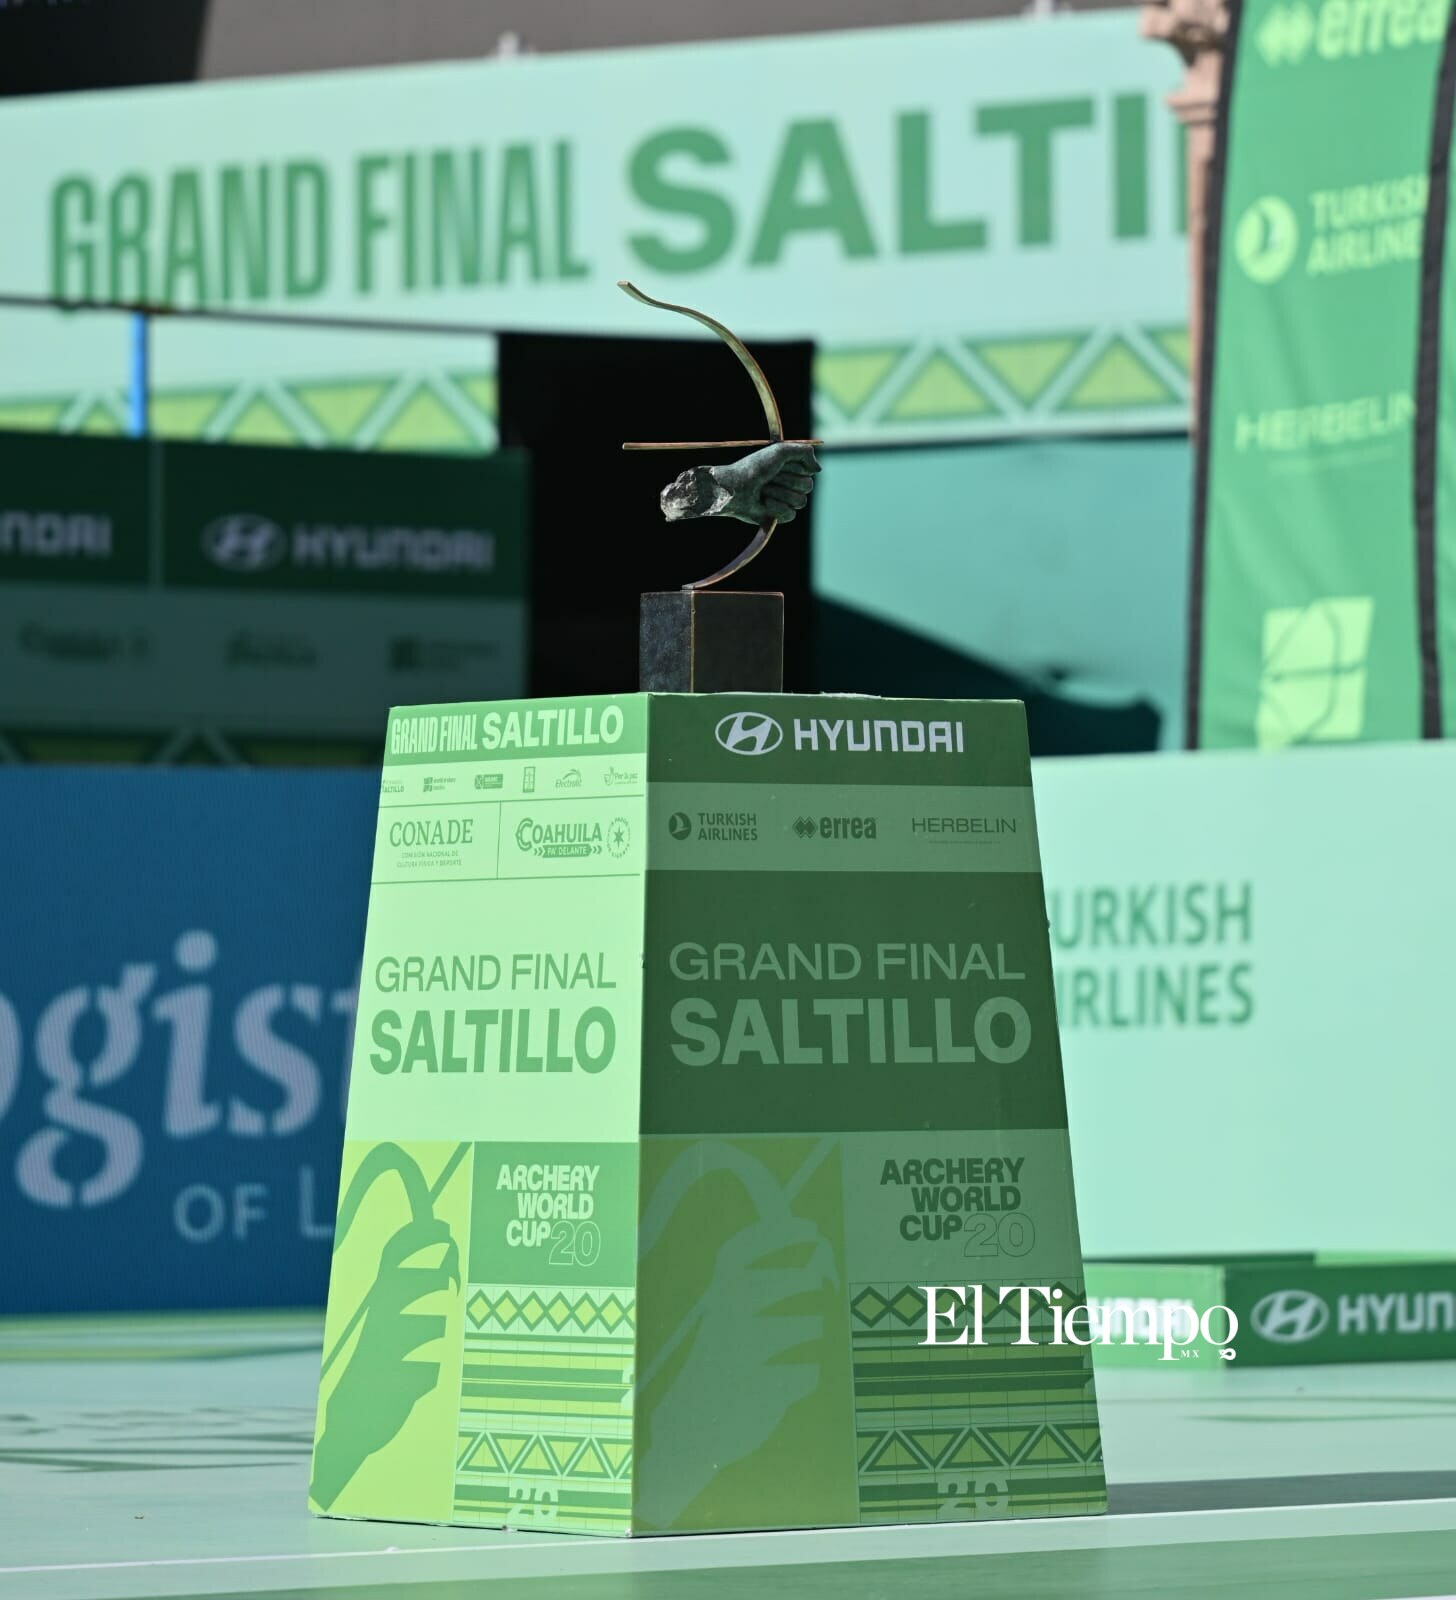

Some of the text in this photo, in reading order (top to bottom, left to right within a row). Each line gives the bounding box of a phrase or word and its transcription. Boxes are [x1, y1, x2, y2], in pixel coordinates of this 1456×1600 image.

[48, 87, 1188, 317] GRAND FINAL SALTI
[292, 522, 496, 572] HYUNDAI
[391, 705, 624, 755] GRAND FINAL SALTILLO
[794, 719, 964, 753] HYUNDAI
[381, 784, 405, 793] ALTILLO
[389, 818, 474, 847] CONADE
[515, 817, 603, 852] COAHUILA
[697, 812, 758, 827] TURKISH
[697, 827, 758, 842] AIRLINES
[820, 816, 877, 840] errea
[911, 817, 1017, 834] HERBELIN
[1050, 879, 1254, 950] URKISH
[375, 952, 617, 993] GRAND FINAL
[669, 942, 1026, 981] GRAND FINAL
[1055, 961, 1255, 1029] IRLINES
[369, 1006, 617, 1075] SALTILLO
[669, 996, 1032, 1066] SALTILLO
[496, 1164, 600, 1191] ARCHERY
[880, 1156, 1025, 1185] ARCHERY
[172, 1183, 270, 1243] OF
[517, 1192, 594, 1220] WORLD
[911, 1185, 1021, 1213] WORLD
[506, 1219, 601, 1267] CUP 20
[900, 1212, 1036, 1257] CUP 20
